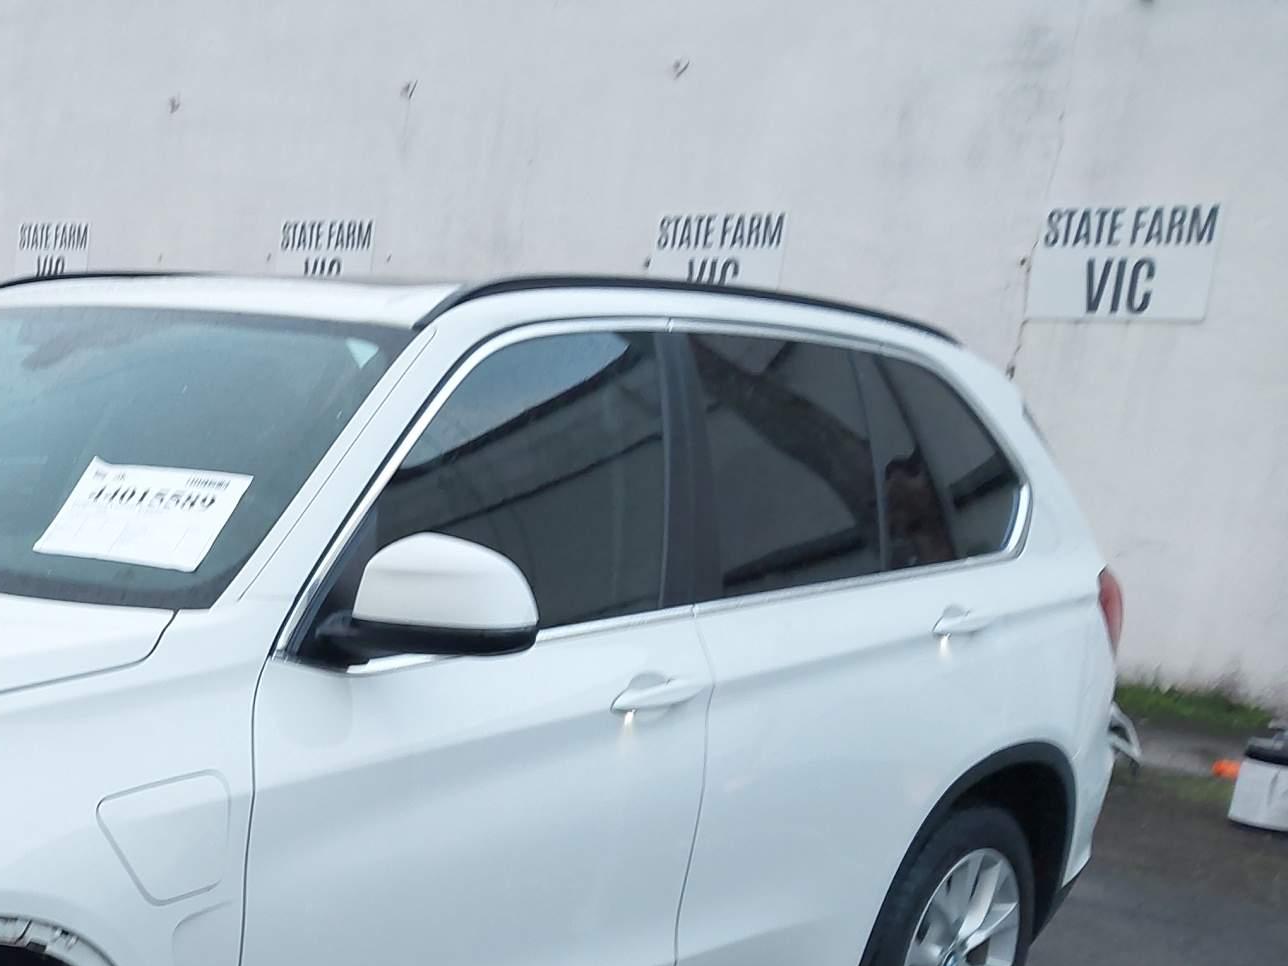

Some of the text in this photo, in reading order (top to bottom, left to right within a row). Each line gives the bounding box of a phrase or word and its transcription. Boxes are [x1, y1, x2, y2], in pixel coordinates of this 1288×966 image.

[19, 222, 88, 251] STATE FARM
[280, 220, 372, 250] STATE FARM
[657, 212, 785, 249] STATE FARM
[1044, 204, 1220, 248] STATE FARM
[1085, 256, 1156, 315] VIC
